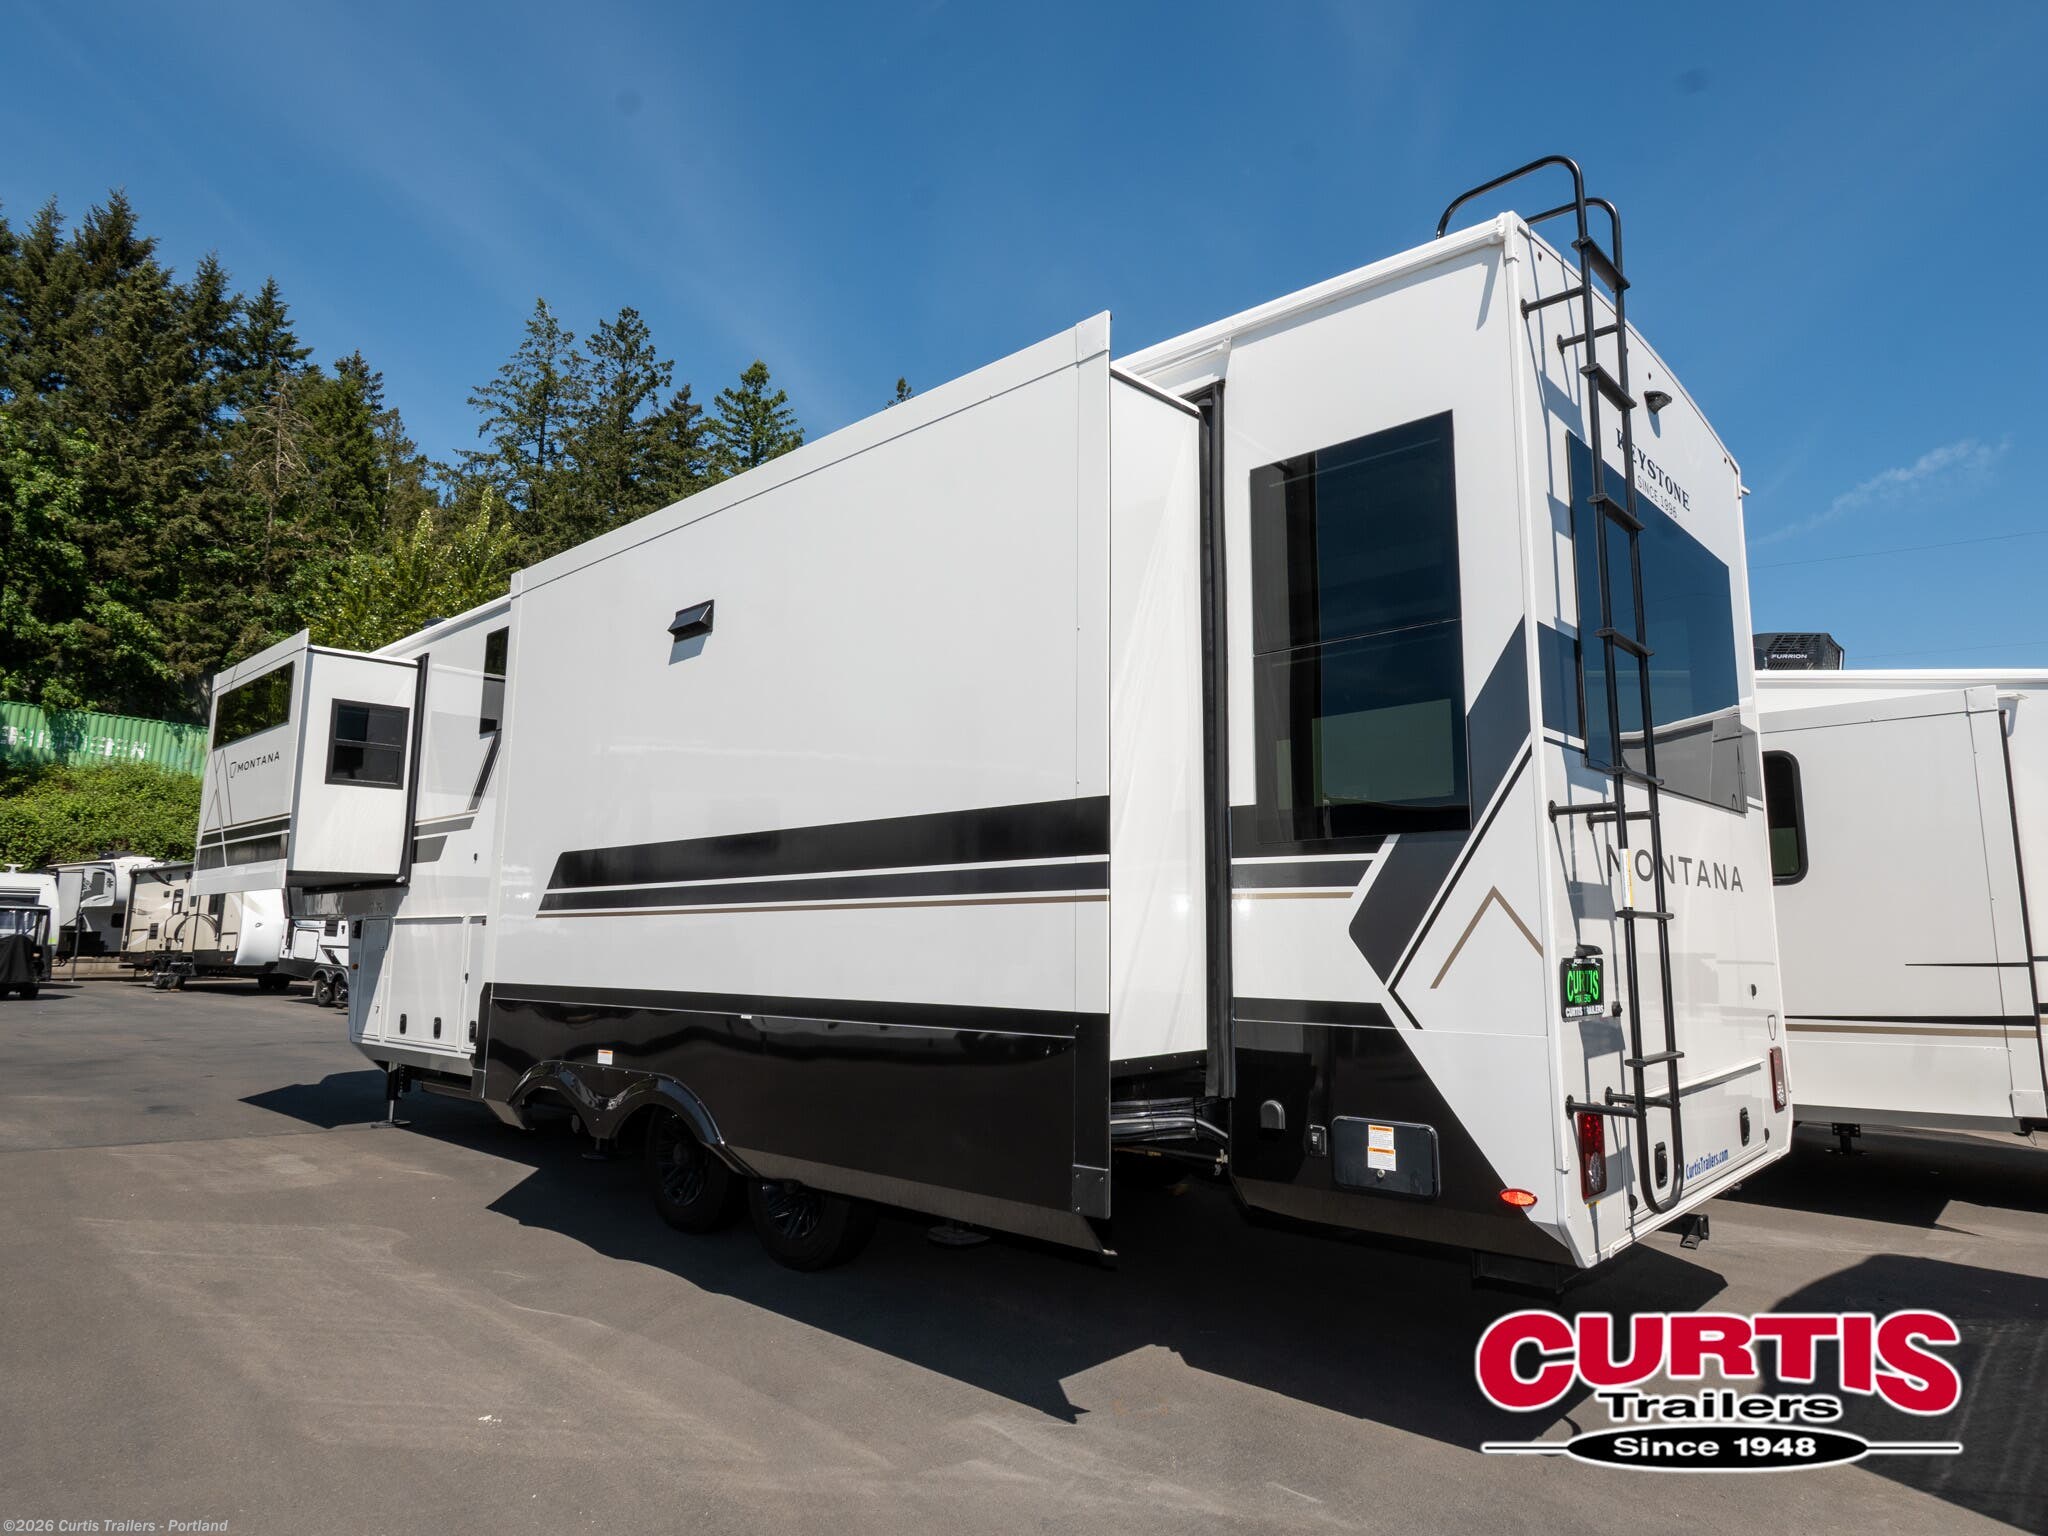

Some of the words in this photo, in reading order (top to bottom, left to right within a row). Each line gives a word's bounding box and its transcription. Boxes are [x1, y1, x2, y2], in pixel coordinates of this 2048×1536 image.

[1637, 475, 1658, 502] SINCE
[237, 751, 280, 773] MONTANA
[1567, 969, 1599, 1002] CURTIS
[1686, 1149, 1728, 1180] CurtisTrailers.com
